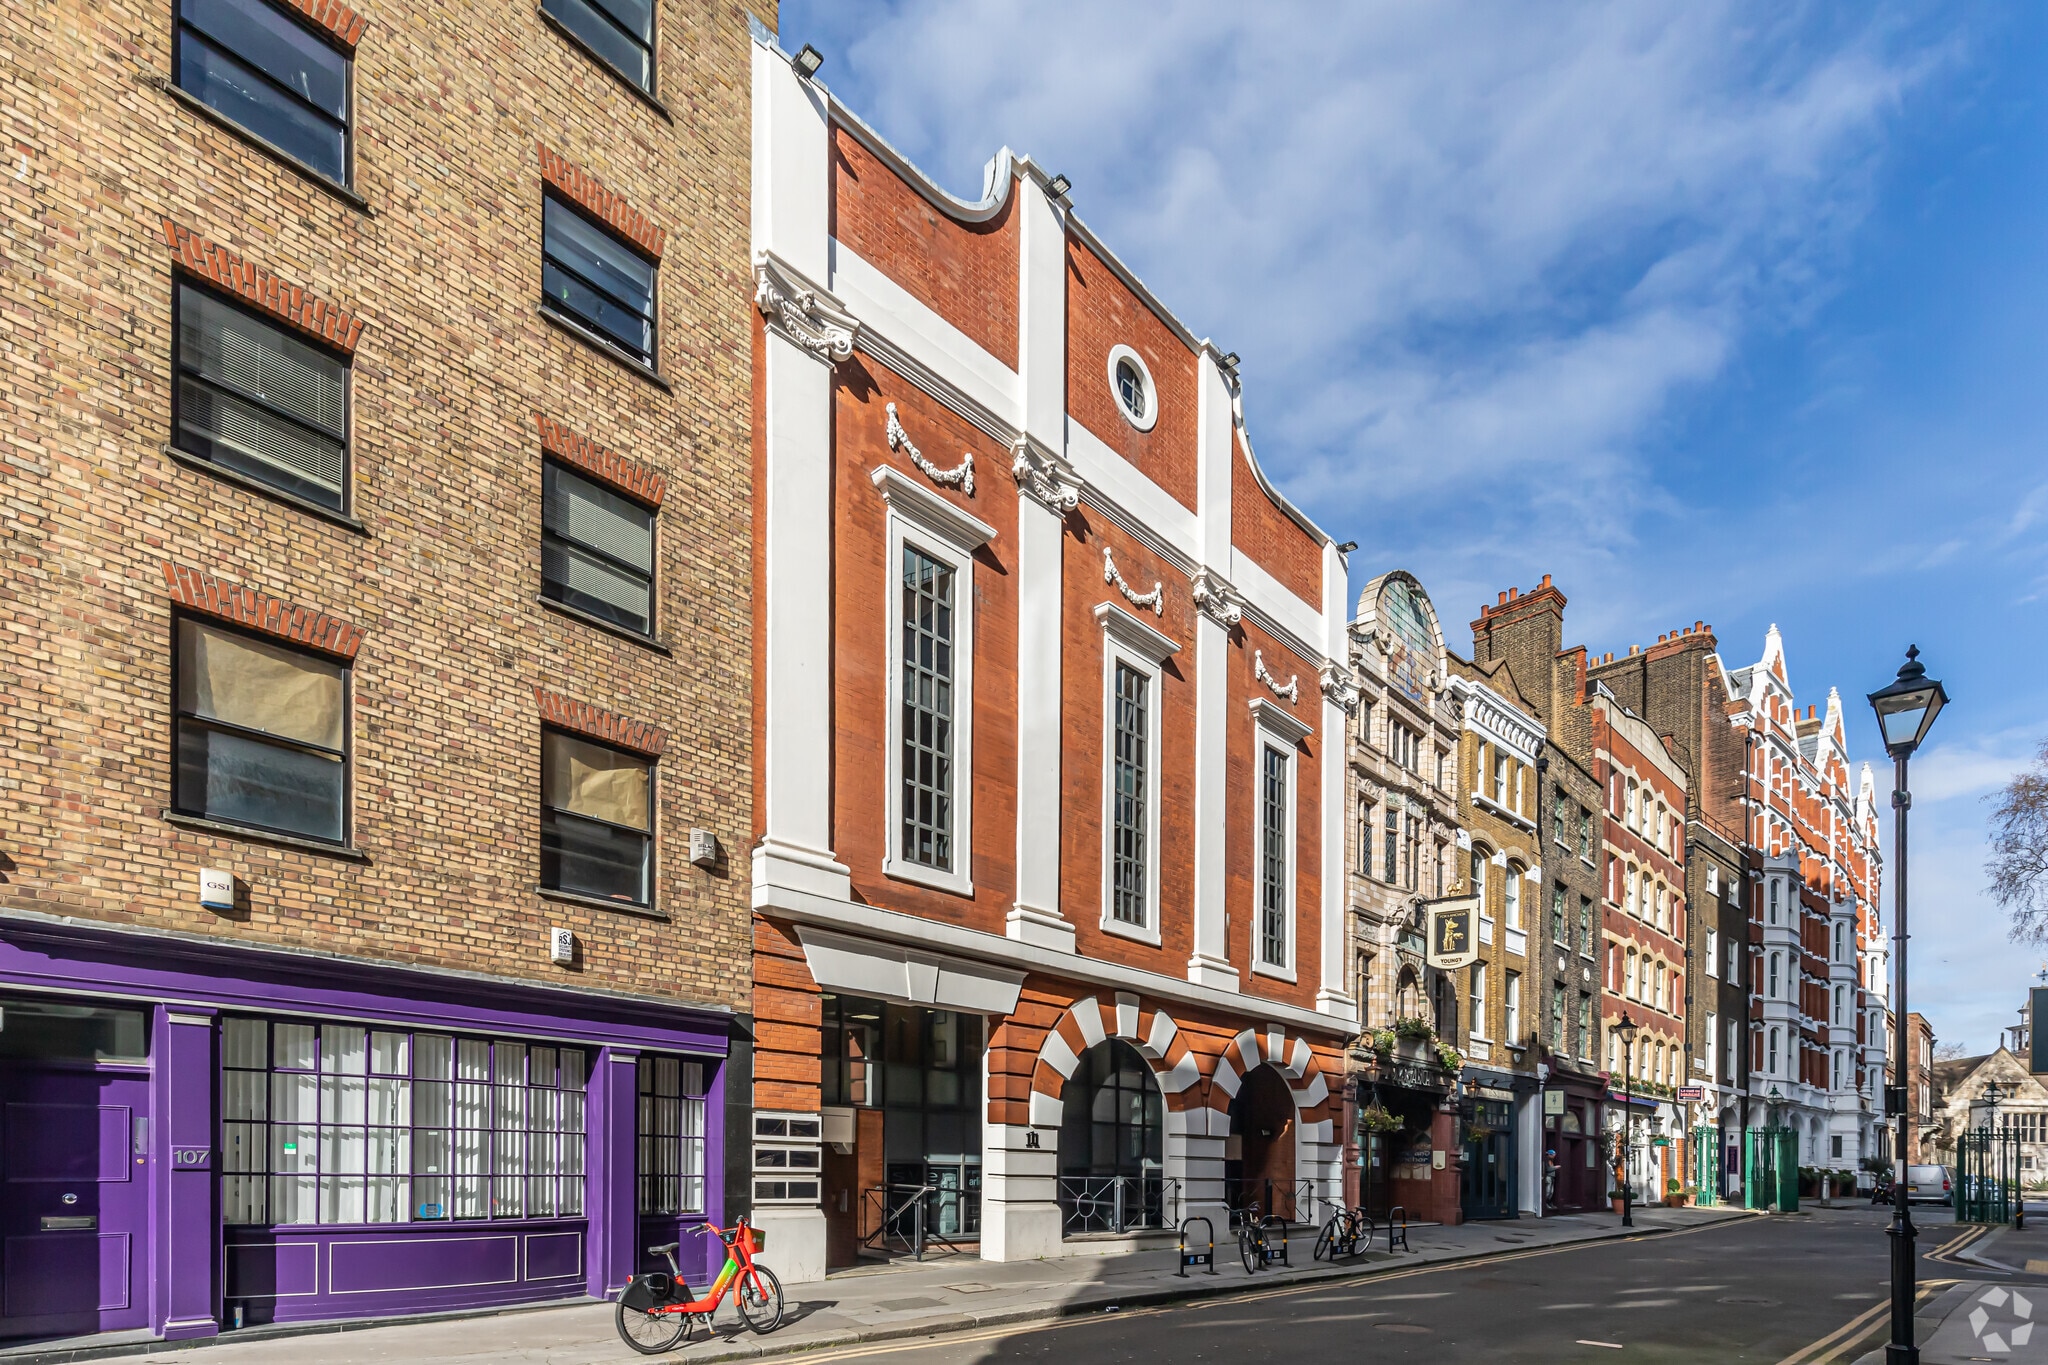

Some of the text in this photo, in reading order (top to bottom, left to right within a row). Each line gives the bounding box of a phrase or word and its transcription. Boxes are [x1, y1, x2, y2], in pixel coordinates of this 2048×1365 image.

[206, 881, 230, 891] GSI
[558, 934, 572, 946] RSJ
[173, 1150, 210, 1165] 107
